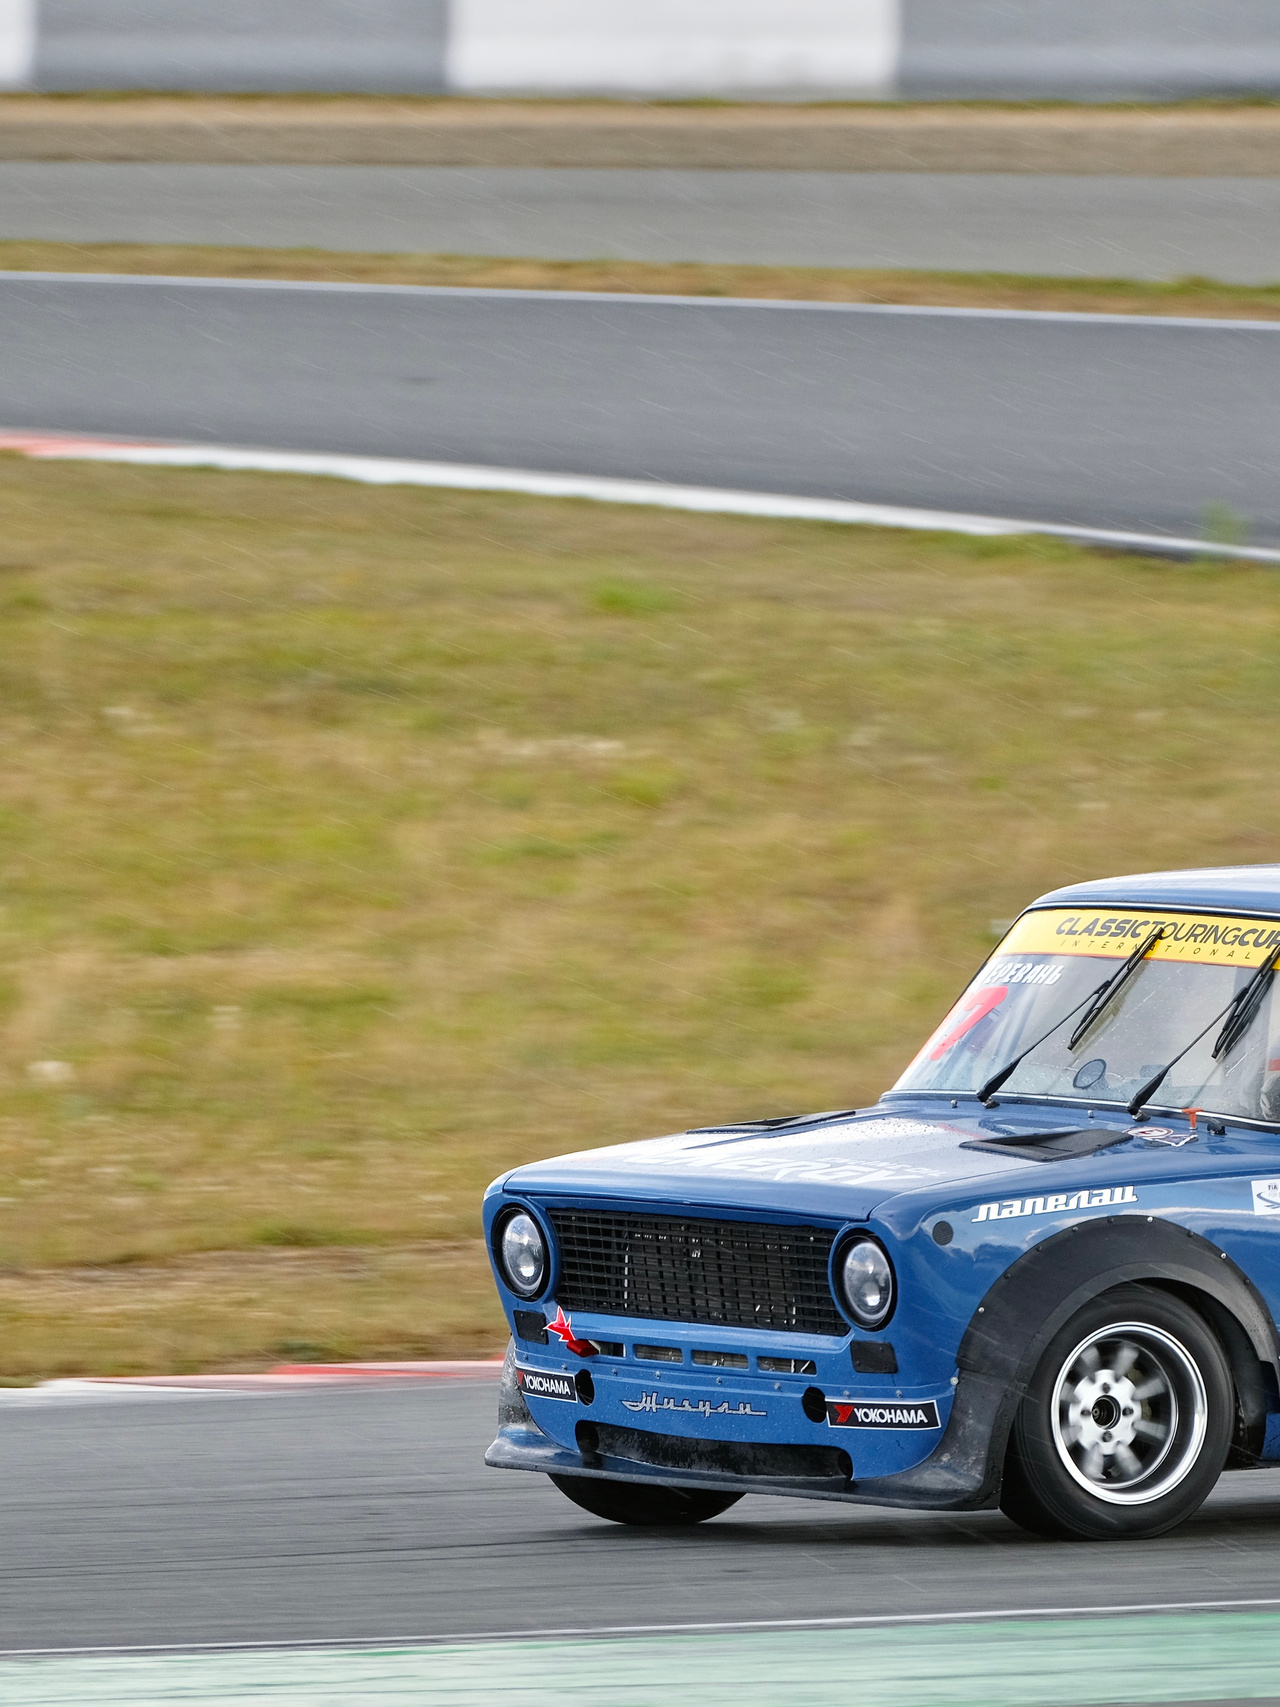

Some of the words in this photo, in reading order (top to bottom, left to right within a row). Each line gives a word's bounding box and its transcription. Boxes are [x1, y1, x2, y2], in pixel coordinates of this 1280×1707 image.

[1060, 940, 1252, 960] INTERNATIONAL
[982, 963, 1065, 985] ЕРЕВАНЬ
[523, 1373, 571, 1396] YOKOHAMA
[621, 1391, 767, 1418] Жигули
[853, 1407, 928, 1424] YOKOHAMA
